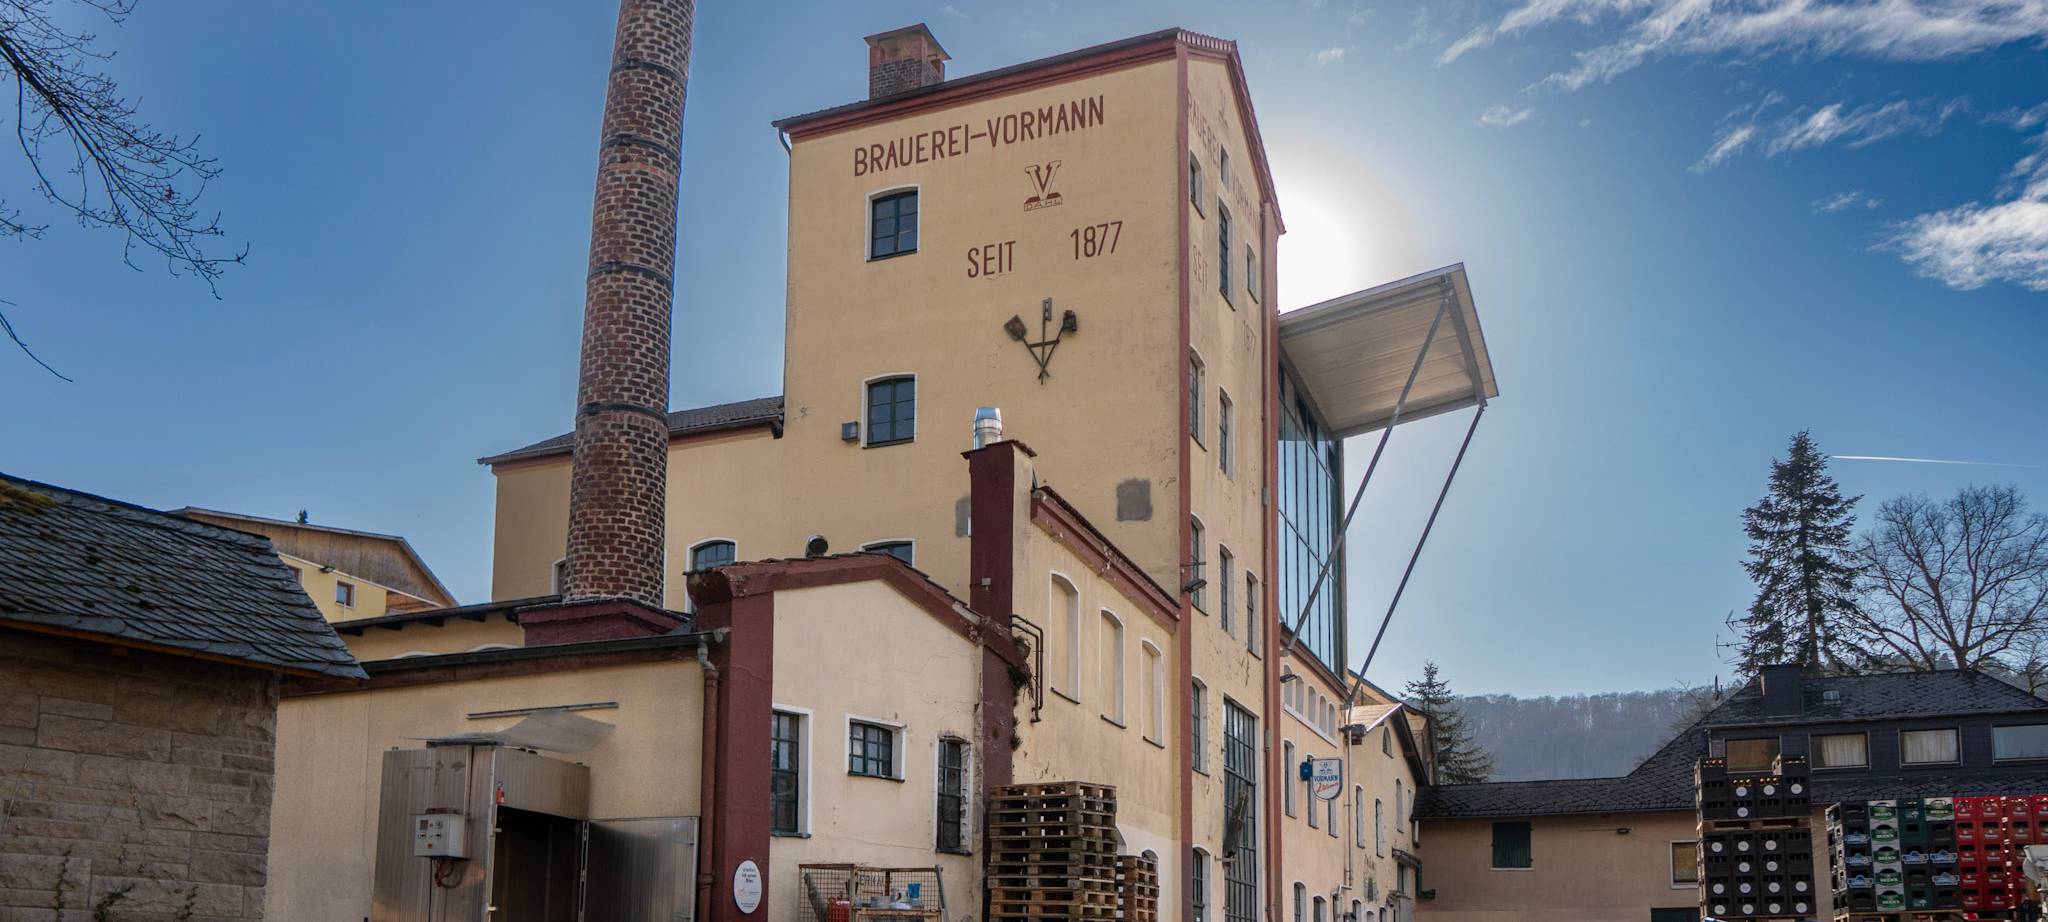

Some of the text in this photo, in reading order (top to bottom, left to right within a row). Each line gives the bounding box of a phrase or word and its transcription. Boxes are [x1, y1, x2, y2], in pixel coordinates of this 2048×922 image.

[854, 95, 1104, 177] BRAUEREI-VORMANN
[1187, 88, 1220, 170] RAUEREI
[1025, 160, 1062, 200] V
[1025, 198, 1062, 211] DAHL
[967, 220, 1123, 278] SEIT 1877
